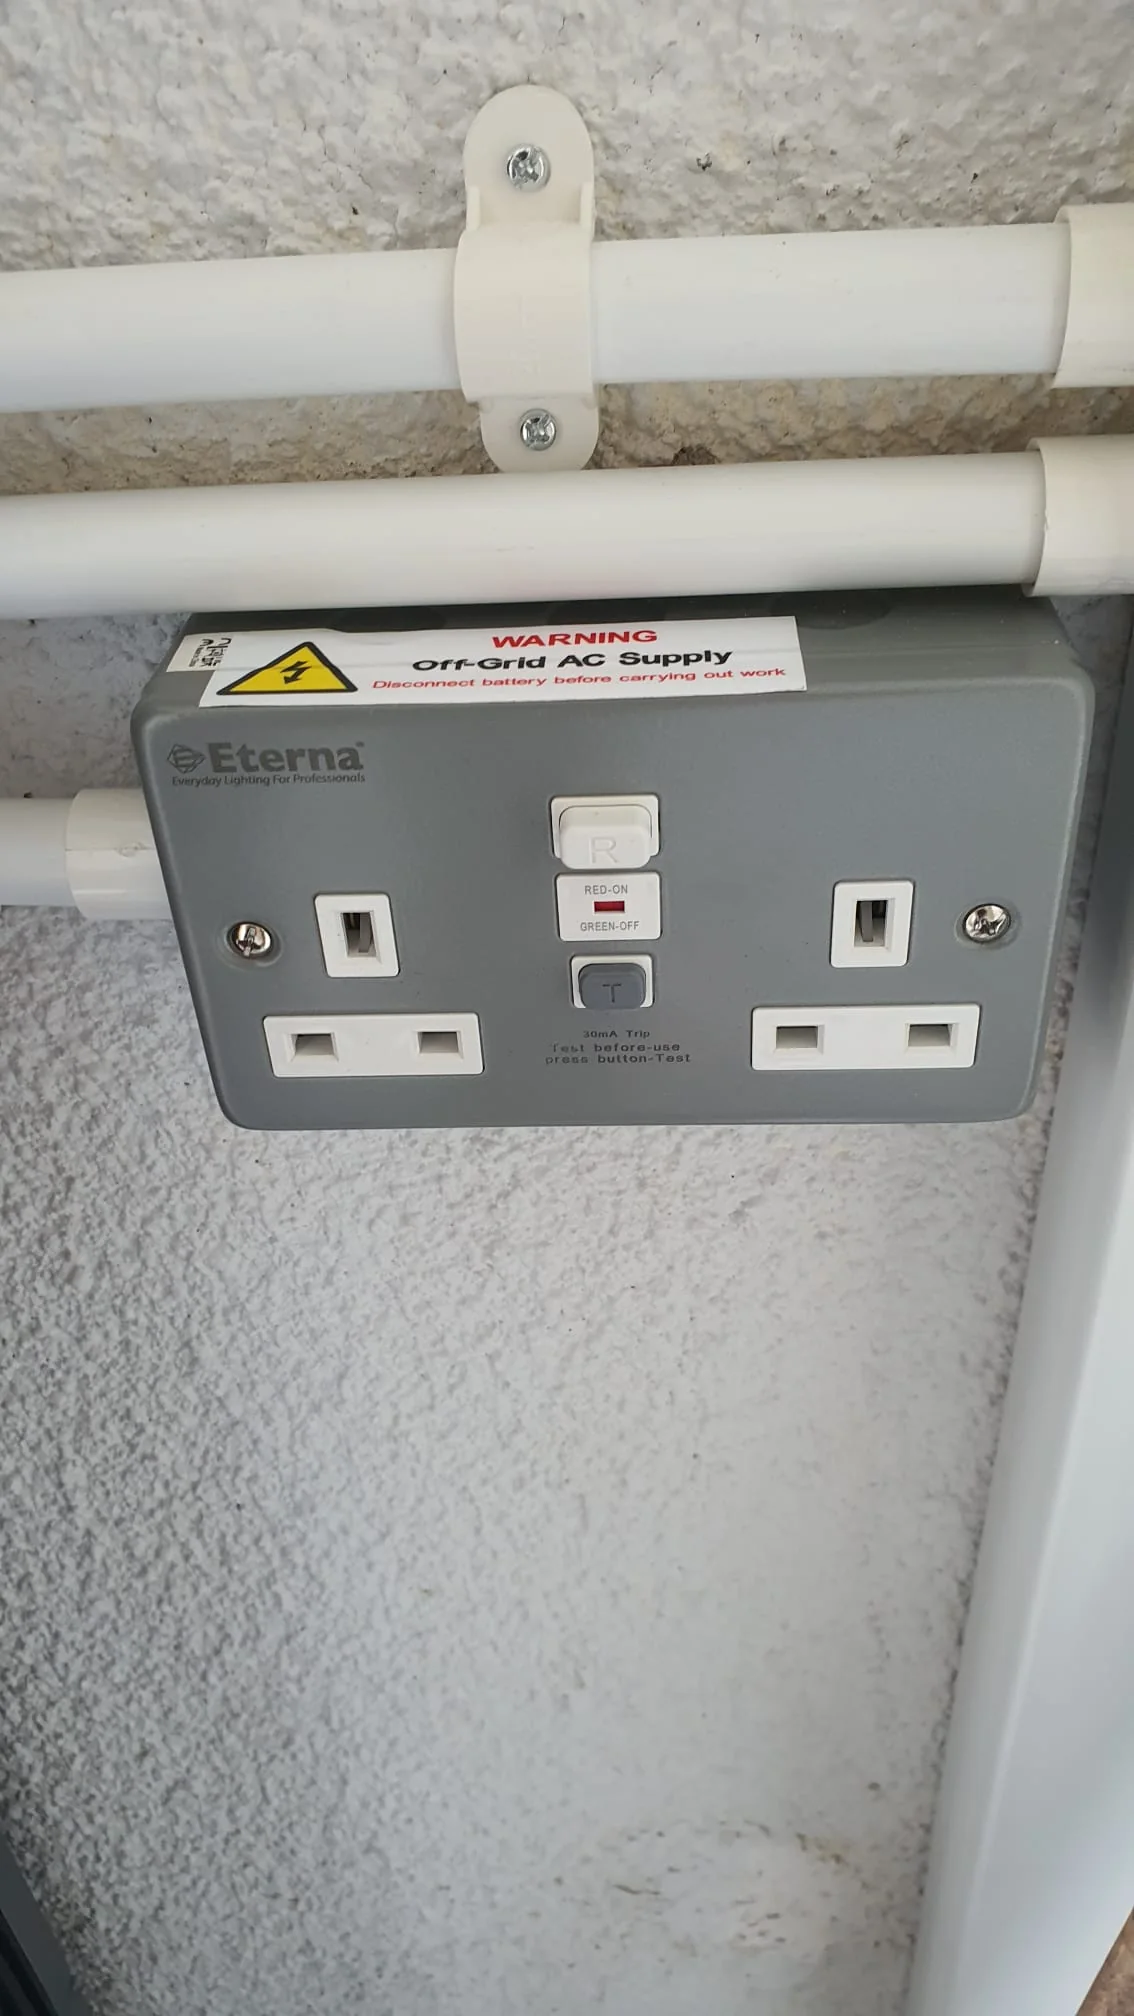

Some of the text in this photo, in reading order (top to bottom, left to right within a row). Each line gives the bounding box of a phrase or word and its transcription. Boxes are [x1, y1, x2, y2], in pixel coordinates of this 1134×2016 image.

[492, 630, 657, 648] WARNING
[412, 650, 733, 671] Off-Grid AC Supply
[373, 667, 786, 689] Disconnect battery before carrying out work
[206, 741, 364, 773] Eterna
[172, 772, 366, 788] Everyday Lighting For Professionals
[590, 836, 618, 863] R
[584, 884, 628, 895] RED-ON
[580, 920, 640, 932] GREEN-OFF
[602, 983, 622, 1003] T
[583, 1029, 651, 1039] 30mA Trip
[552, 1043, 681, 1053] Test before-use
[545, 1053, 691, 1065] press button-Test
